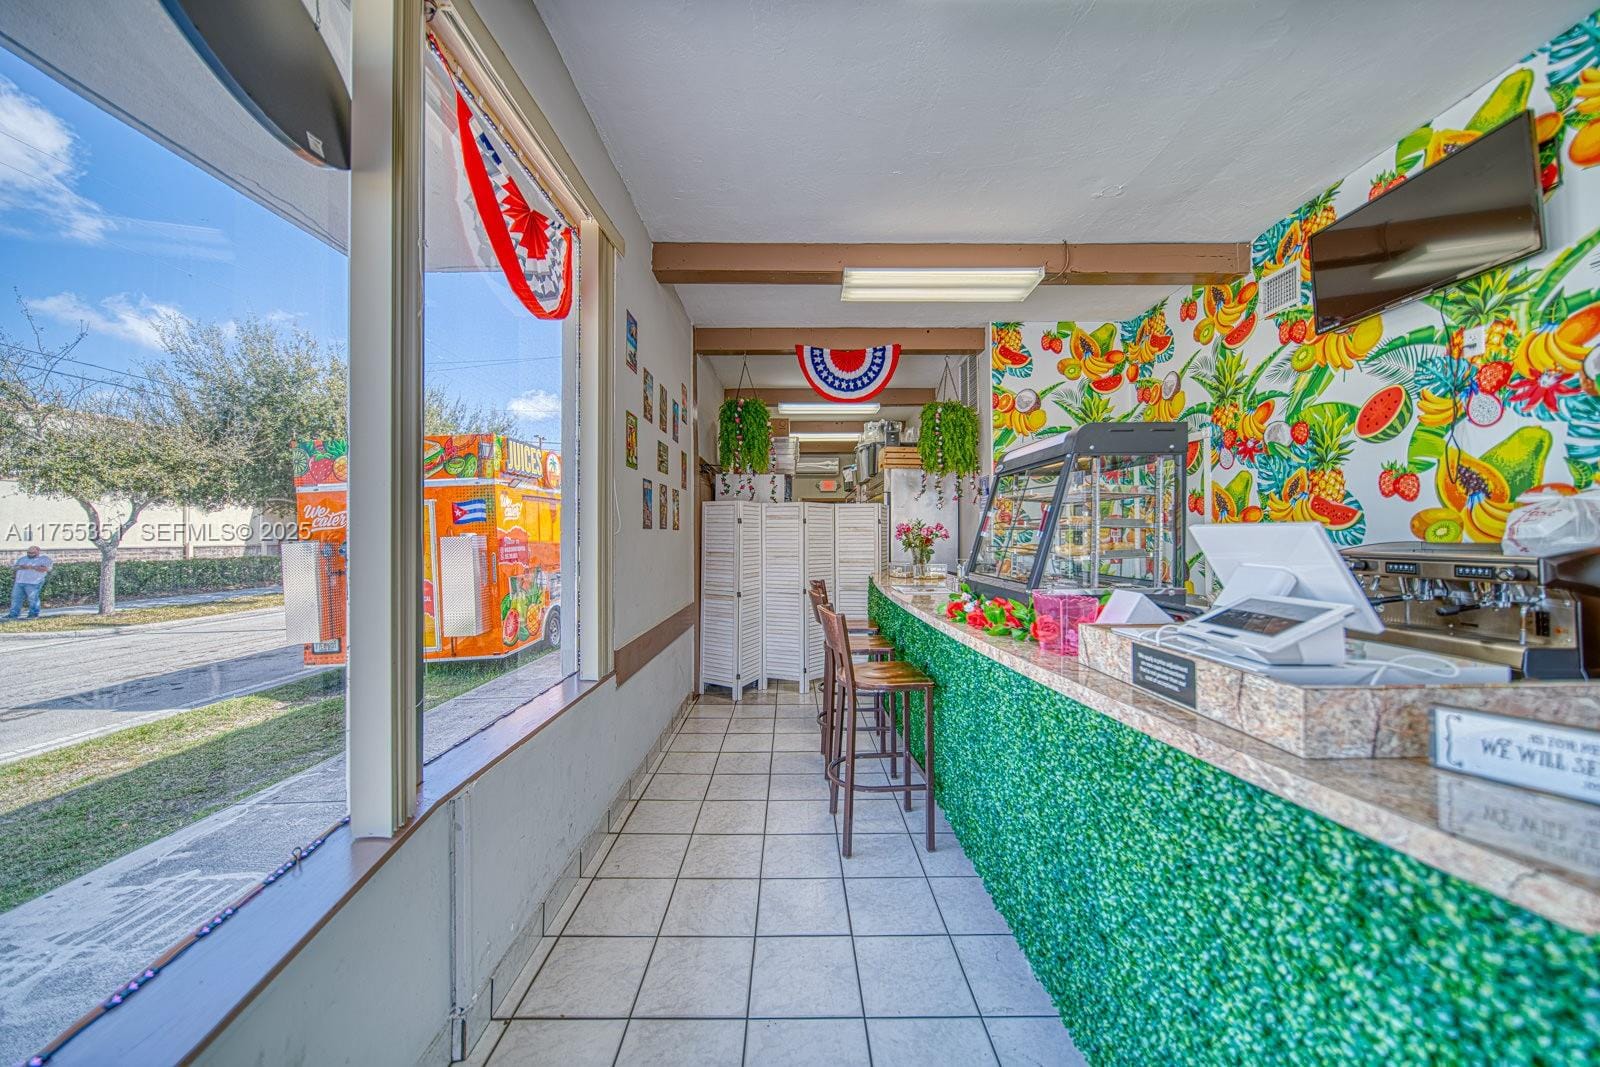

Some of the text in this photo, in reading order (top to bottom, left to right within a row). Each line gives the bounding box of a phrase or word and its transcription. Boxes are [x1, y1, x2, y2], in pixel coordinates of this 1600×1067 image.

[508, 440, 543, 477] JUICES
[303, 504, 330, 519] We
[311, 510, 347, 529] cater
[1480, 737, 1512, 760] WE
[1515, 744, 1567, 770] WILL
